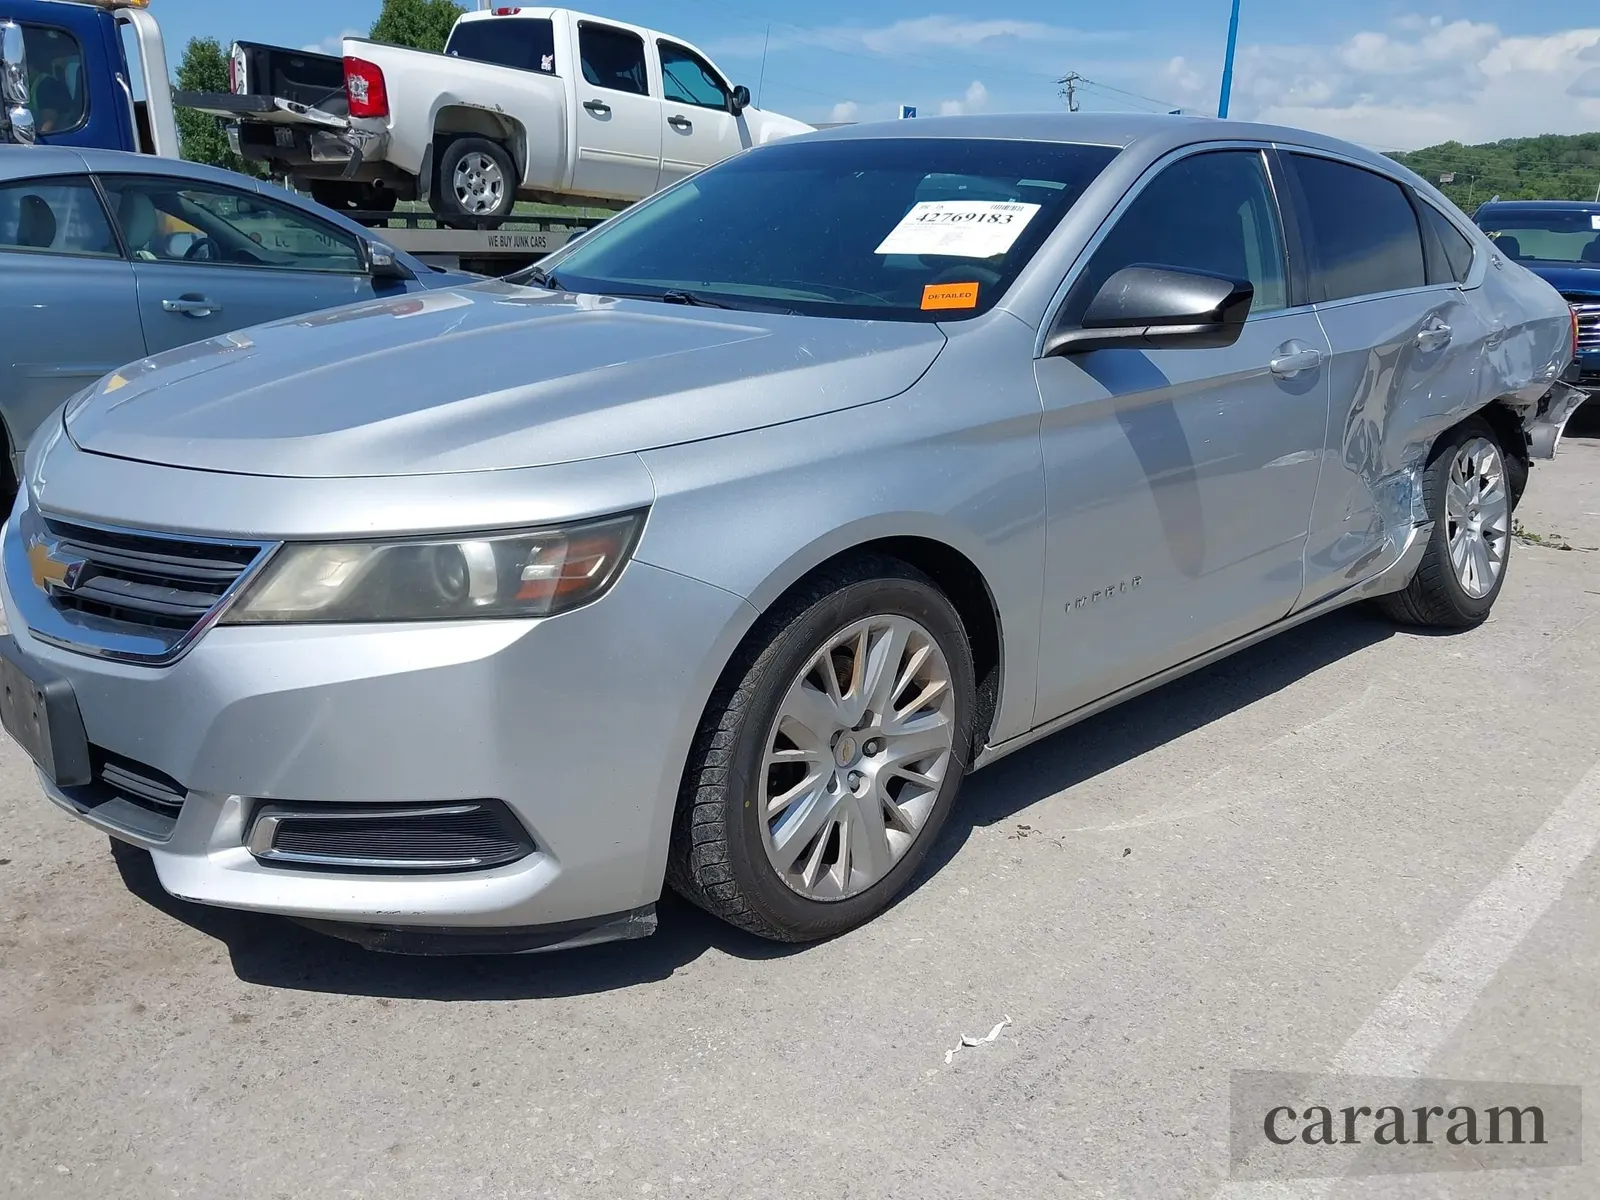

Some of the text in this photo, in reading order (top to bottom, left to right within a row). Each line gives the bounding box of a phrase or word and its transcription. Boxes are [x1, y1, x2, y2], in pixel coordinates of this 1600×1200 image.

[916, 212, 1014, 225] 42769183
[488, 235, 547, 248] WE BUY JUNK CARS
[928, 292, 972, 300] DETAILED
